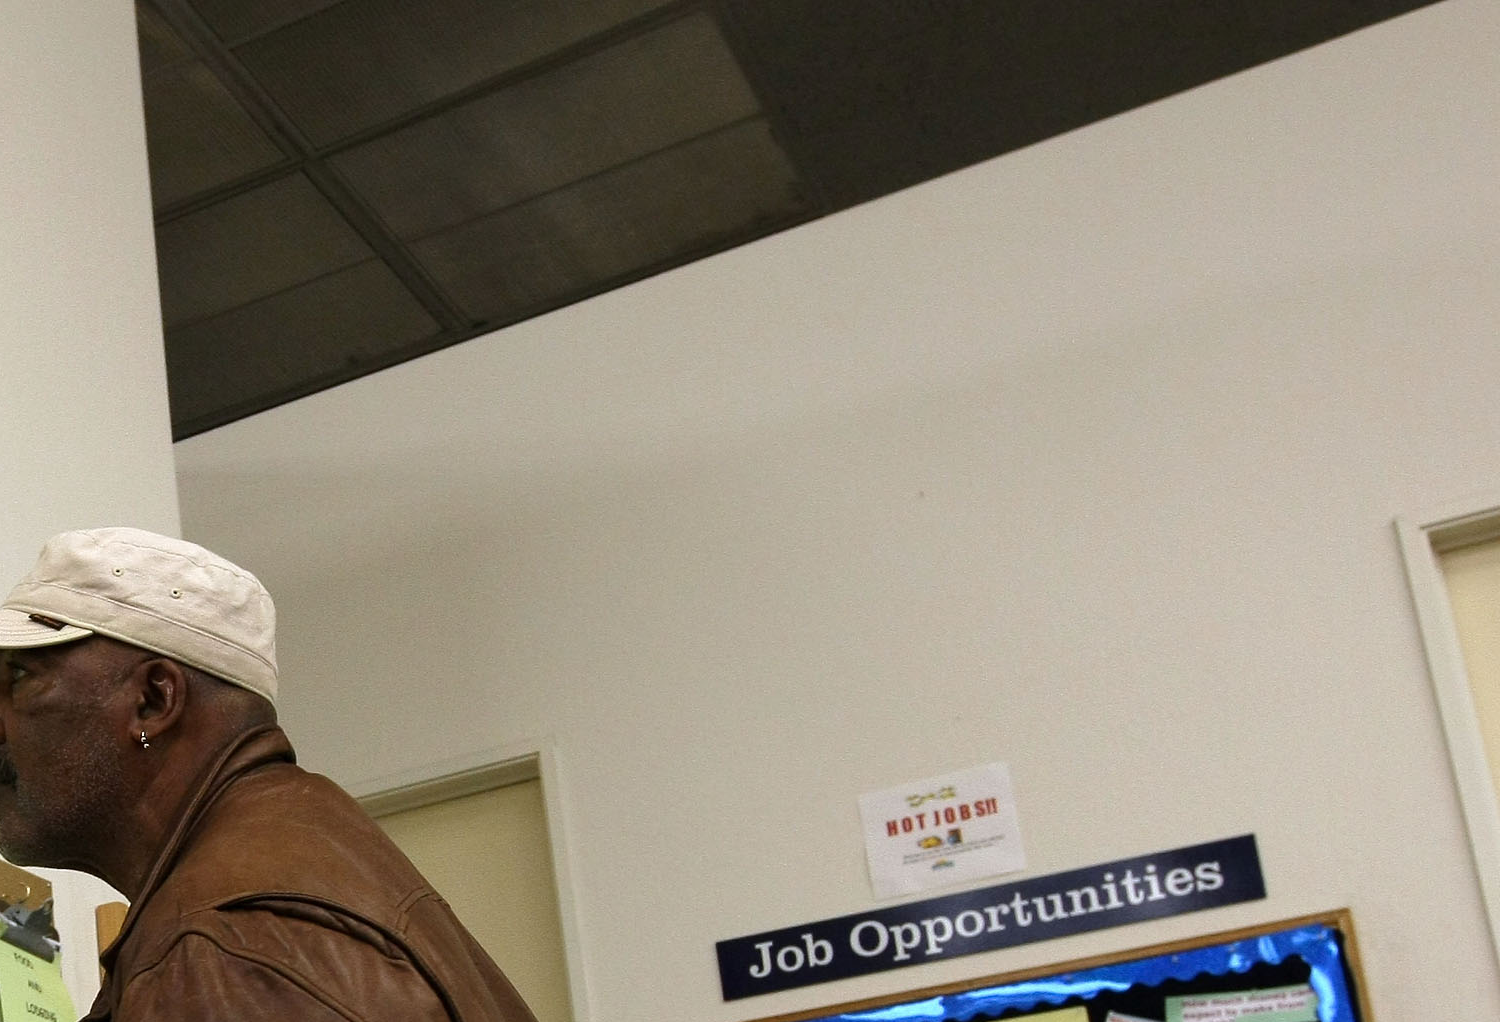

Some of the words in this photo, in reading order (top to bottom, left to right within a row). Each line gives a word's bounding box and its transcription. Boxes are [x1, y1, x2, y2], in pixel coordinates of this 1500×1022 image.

[886, 812, 926, 837] HOT
[933, 797, 998, 827] JOBS!!
[749, 933, 834, 979] Job
[850, 861, 1224, 961] Opportunities
